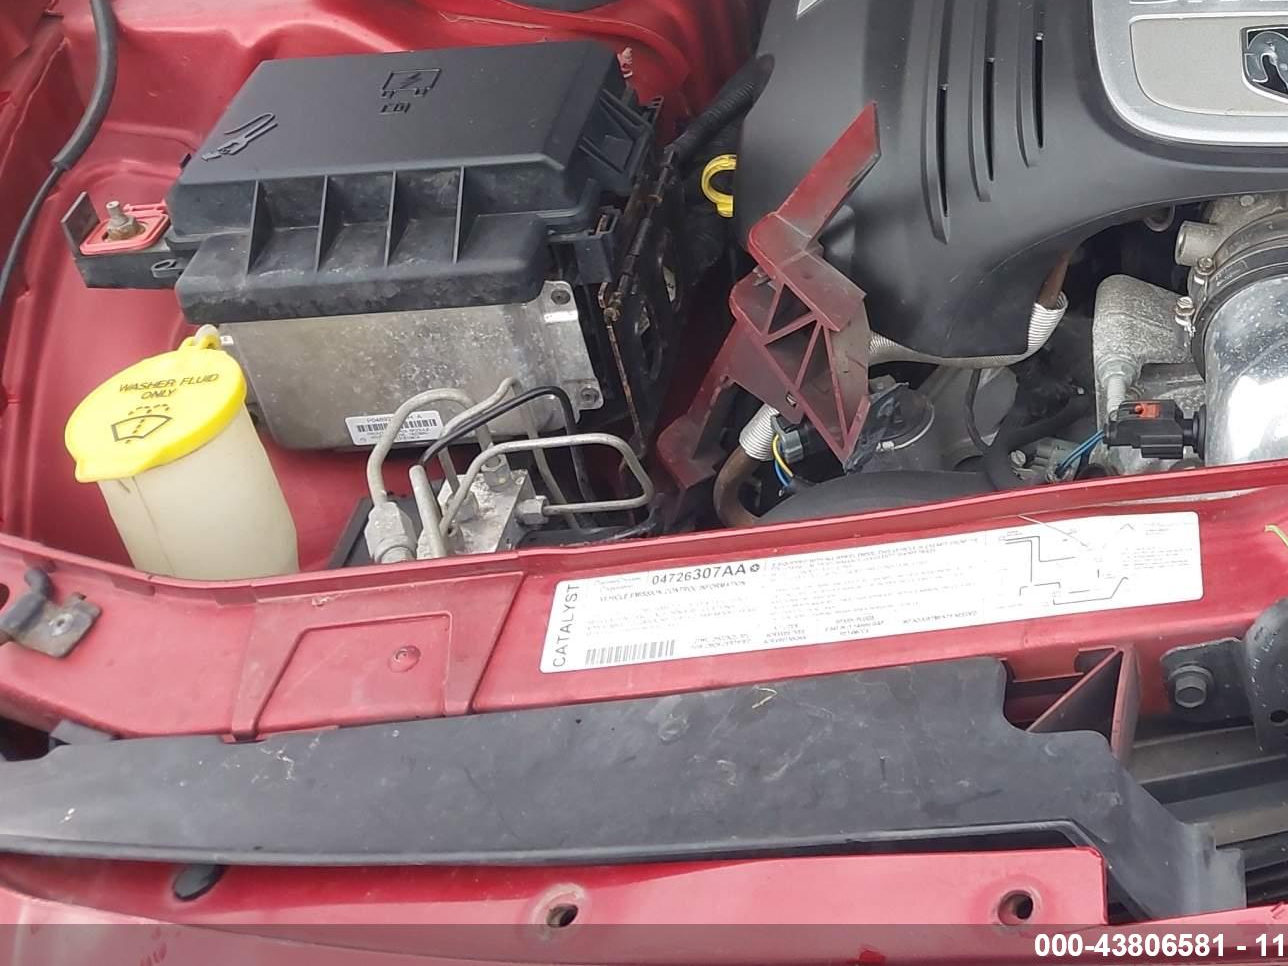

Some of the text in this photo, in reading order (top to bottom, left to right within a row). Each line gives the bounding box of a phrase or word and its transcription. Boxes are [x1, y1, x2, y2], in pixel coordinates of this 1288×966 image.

[120, 374, 219, 392] WASHER FLUID
[141, 388, 176, 399] ONLY
[652, 564, 746, 585] 04726307AA
[552, 583, 580, 667] CATALYST
